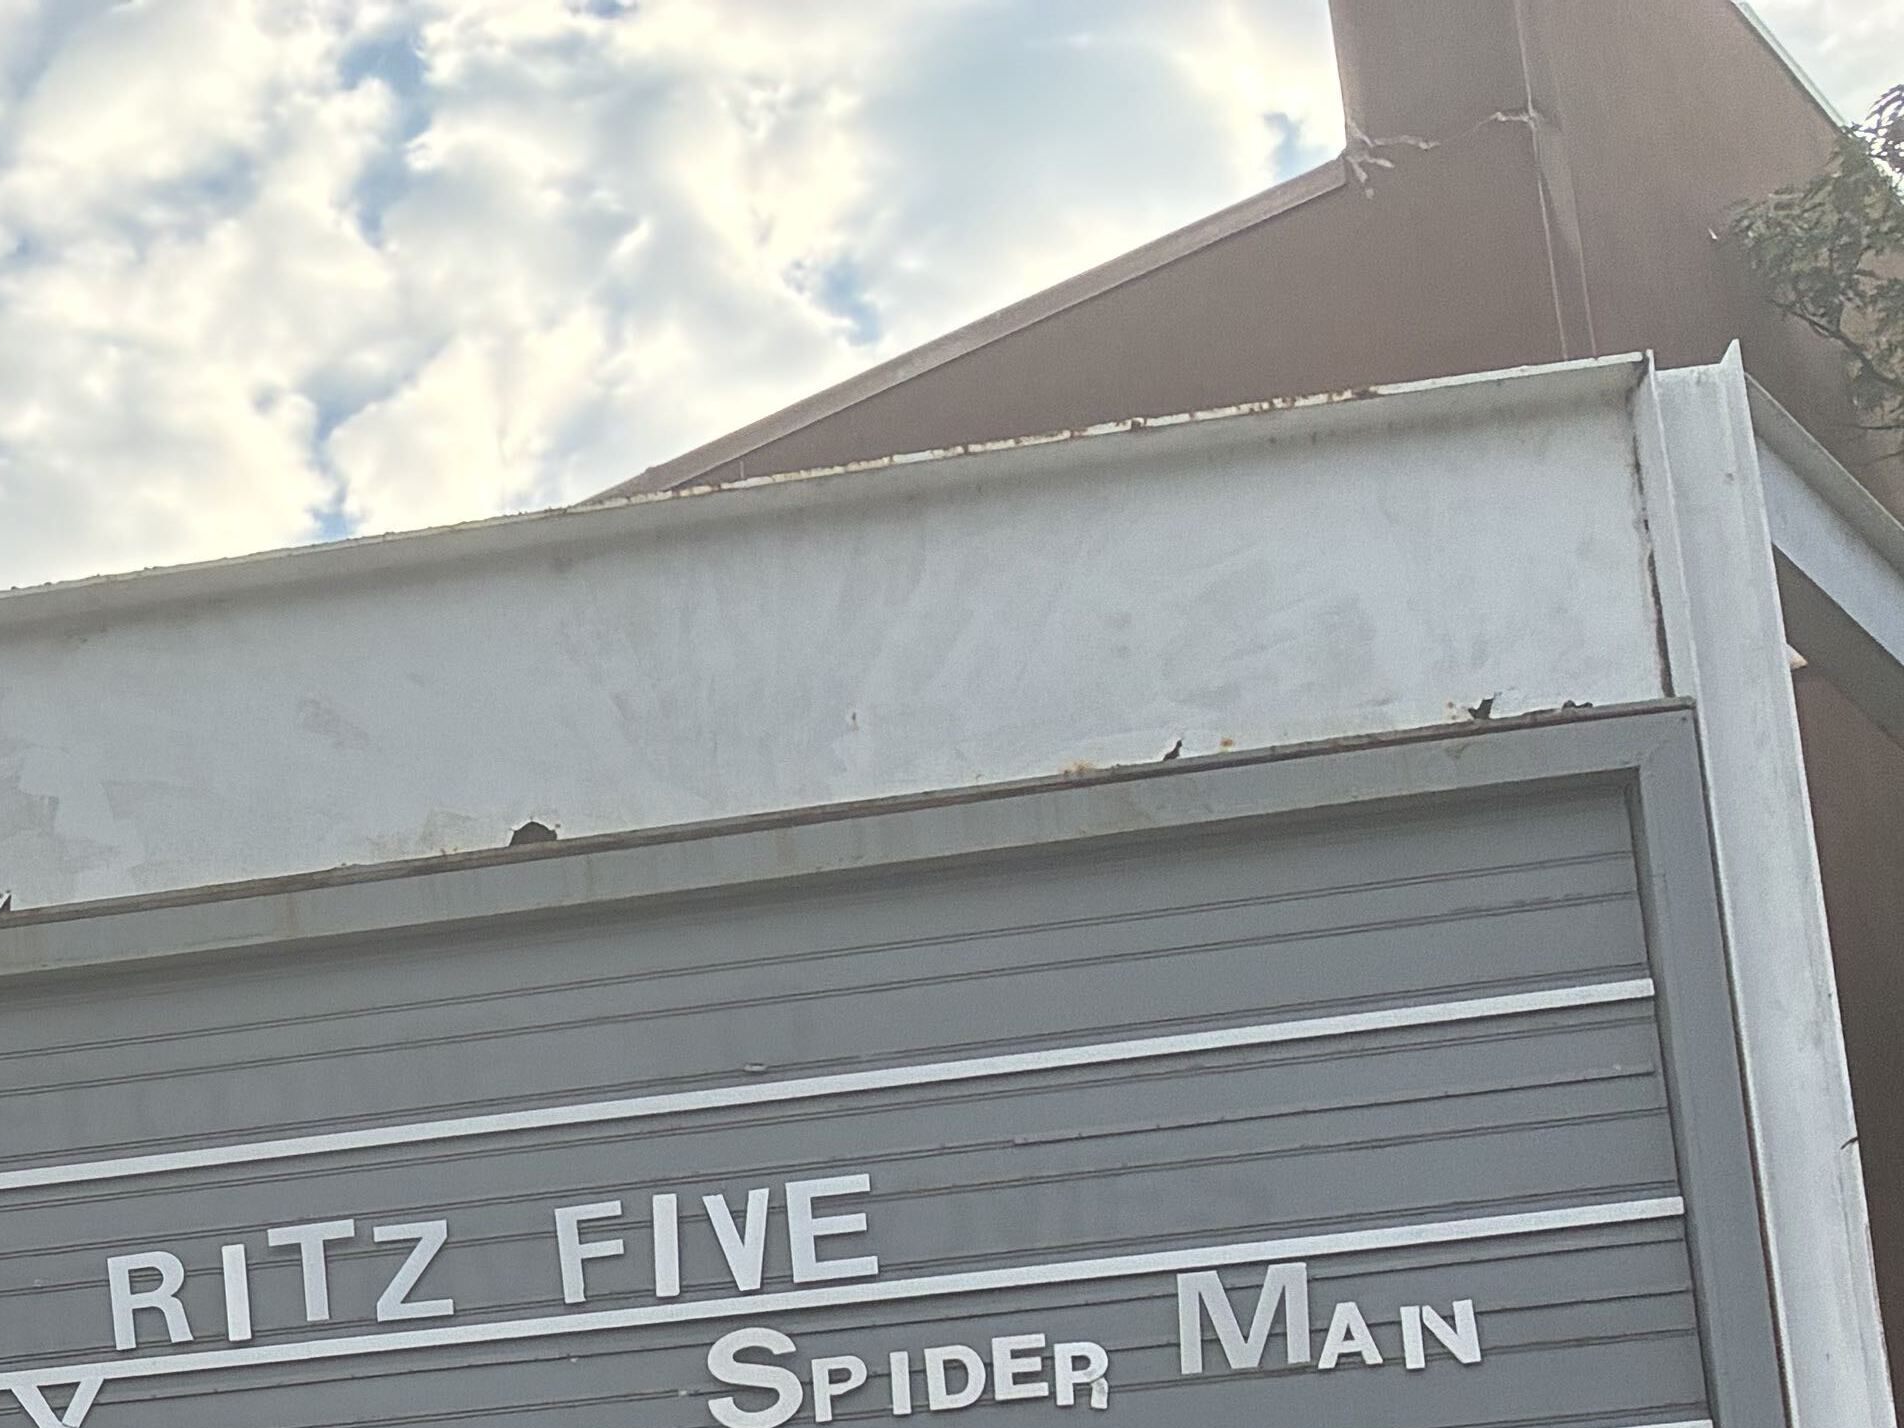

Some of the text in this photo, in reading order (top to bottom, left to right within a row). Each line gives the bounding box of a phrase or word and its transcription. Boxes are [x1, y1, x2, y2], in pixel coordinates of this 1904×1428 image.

[105, 1172, 880, 1352] RITZ FIVE
[1174, 1261, 1483, 1376] MAN
